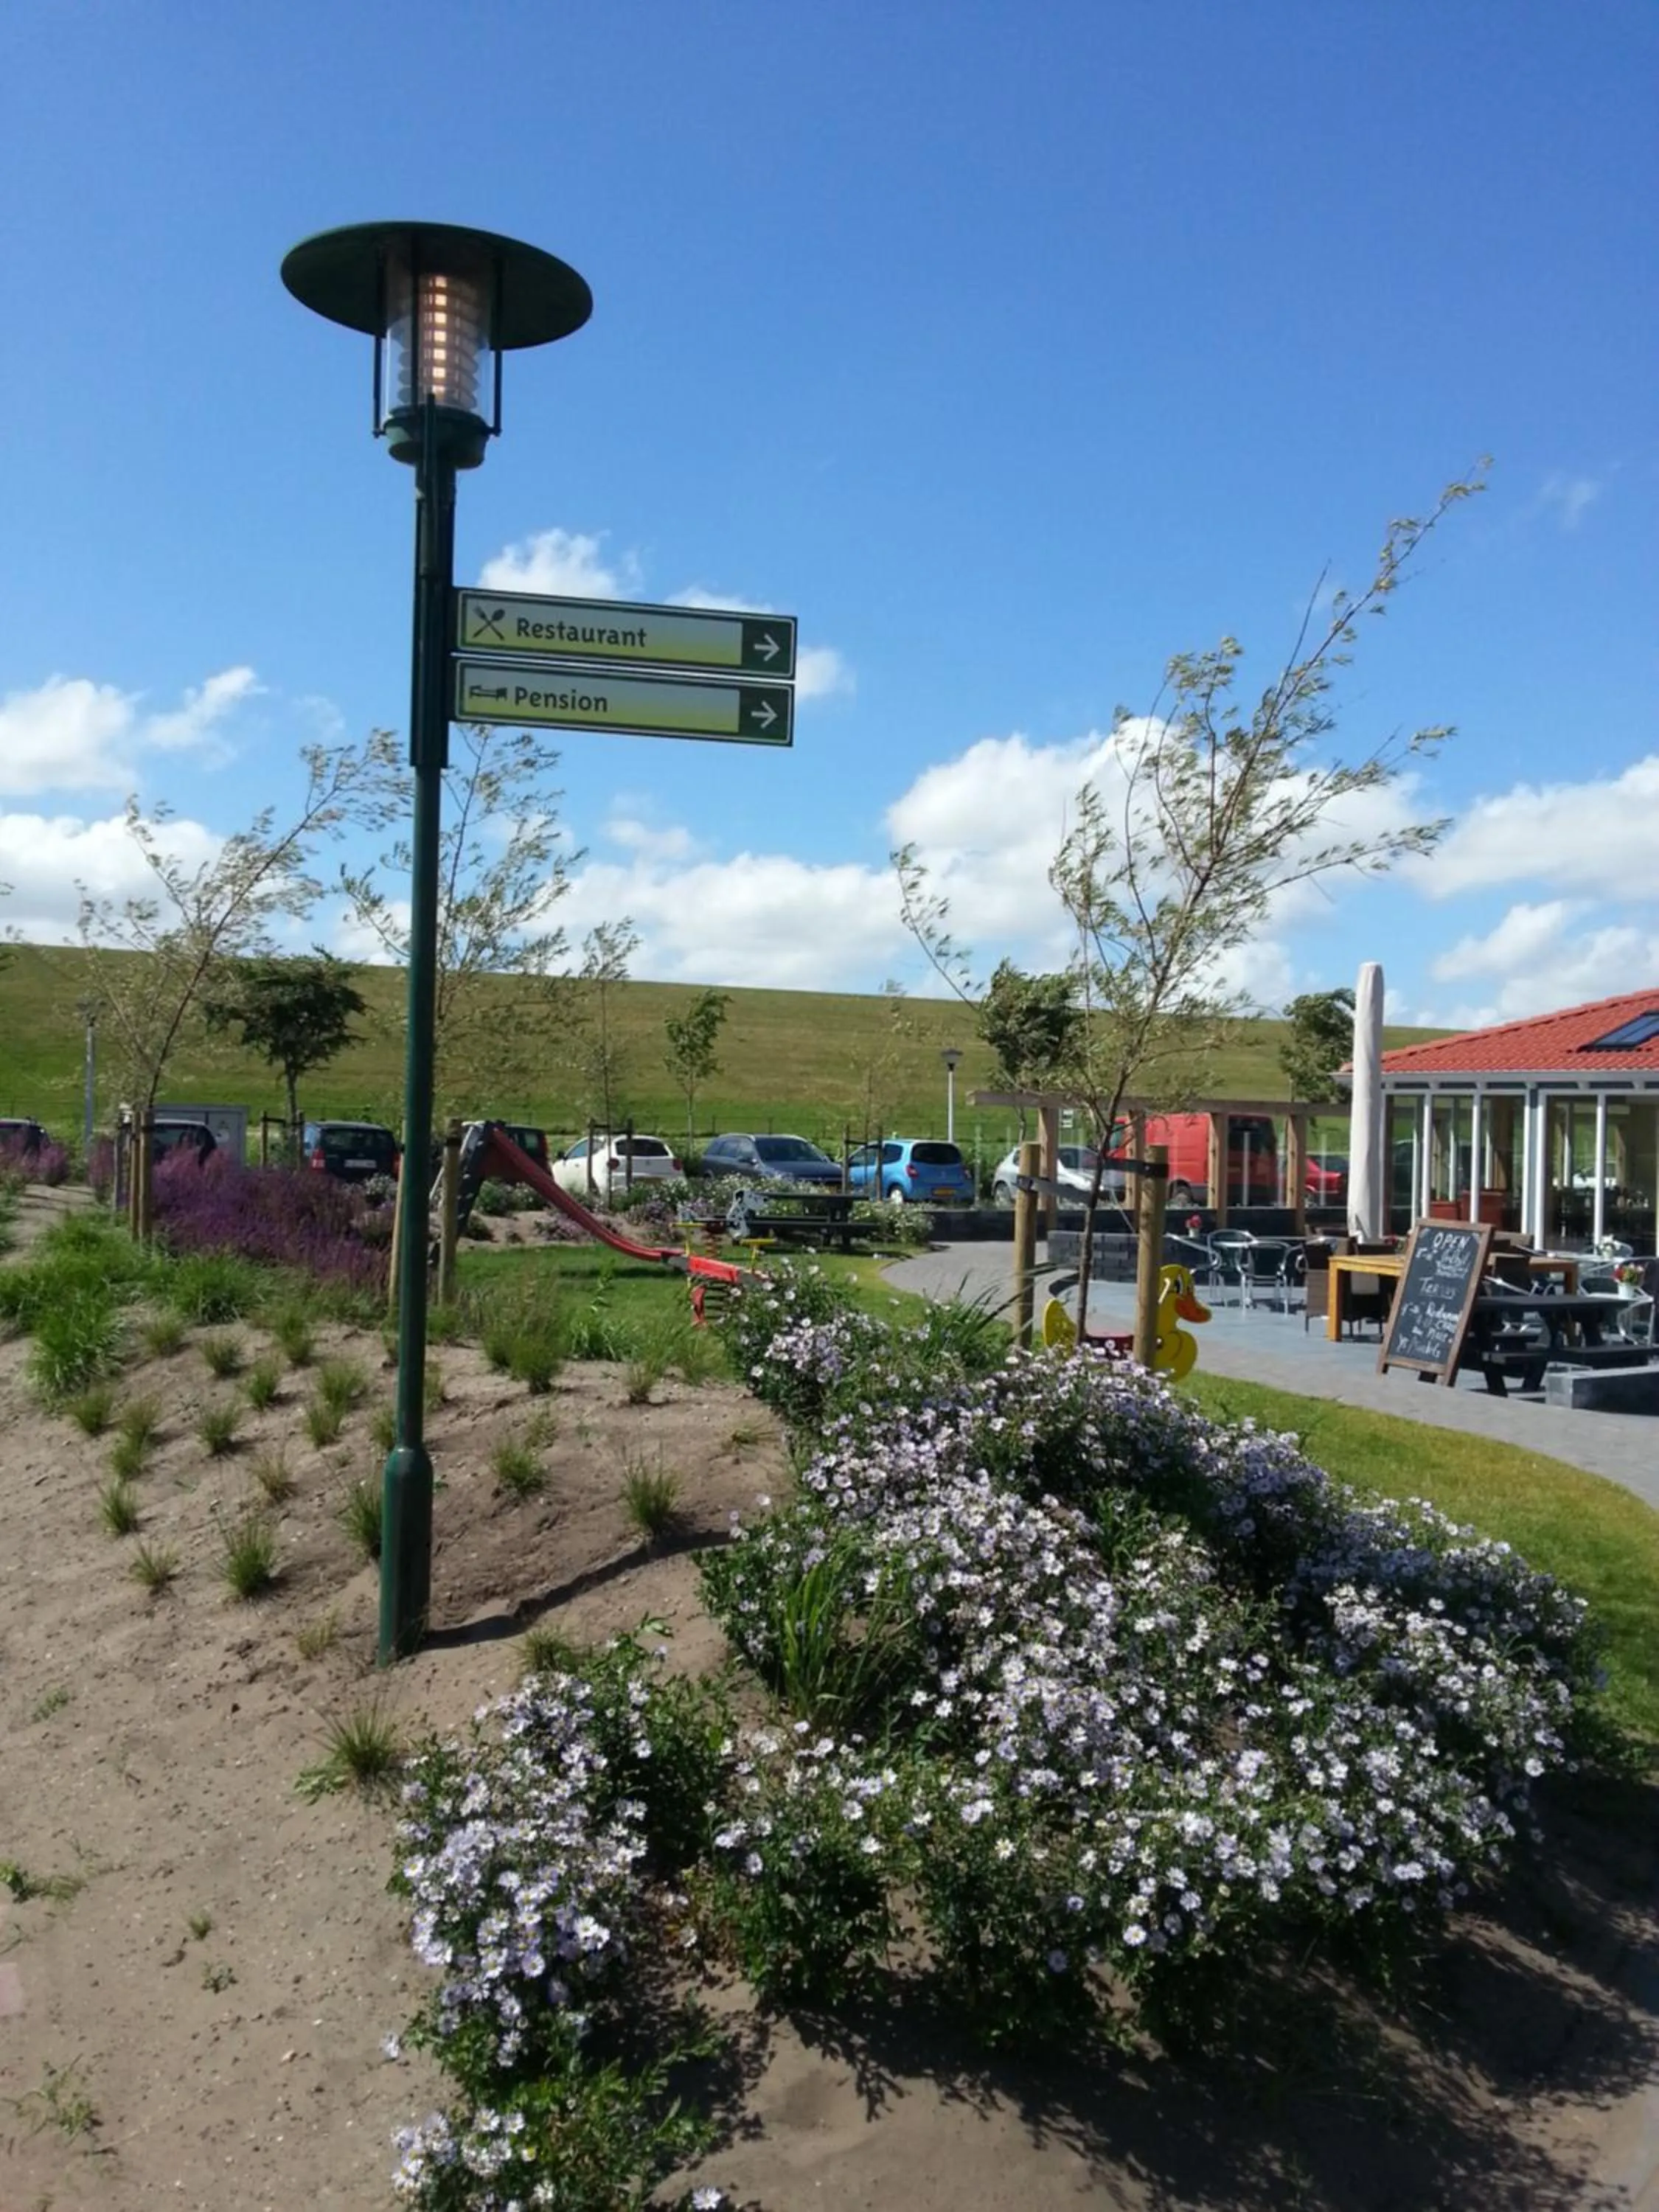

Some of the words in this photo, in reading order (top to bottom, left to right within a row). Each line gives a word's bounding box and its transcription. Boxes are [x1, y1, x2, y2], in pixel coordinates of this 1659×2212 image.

[517, 618, 647, 647] Restaurant
[515, 686, 608, 712] Pension
[1433, 1232, 1470, 1249] OPEN
